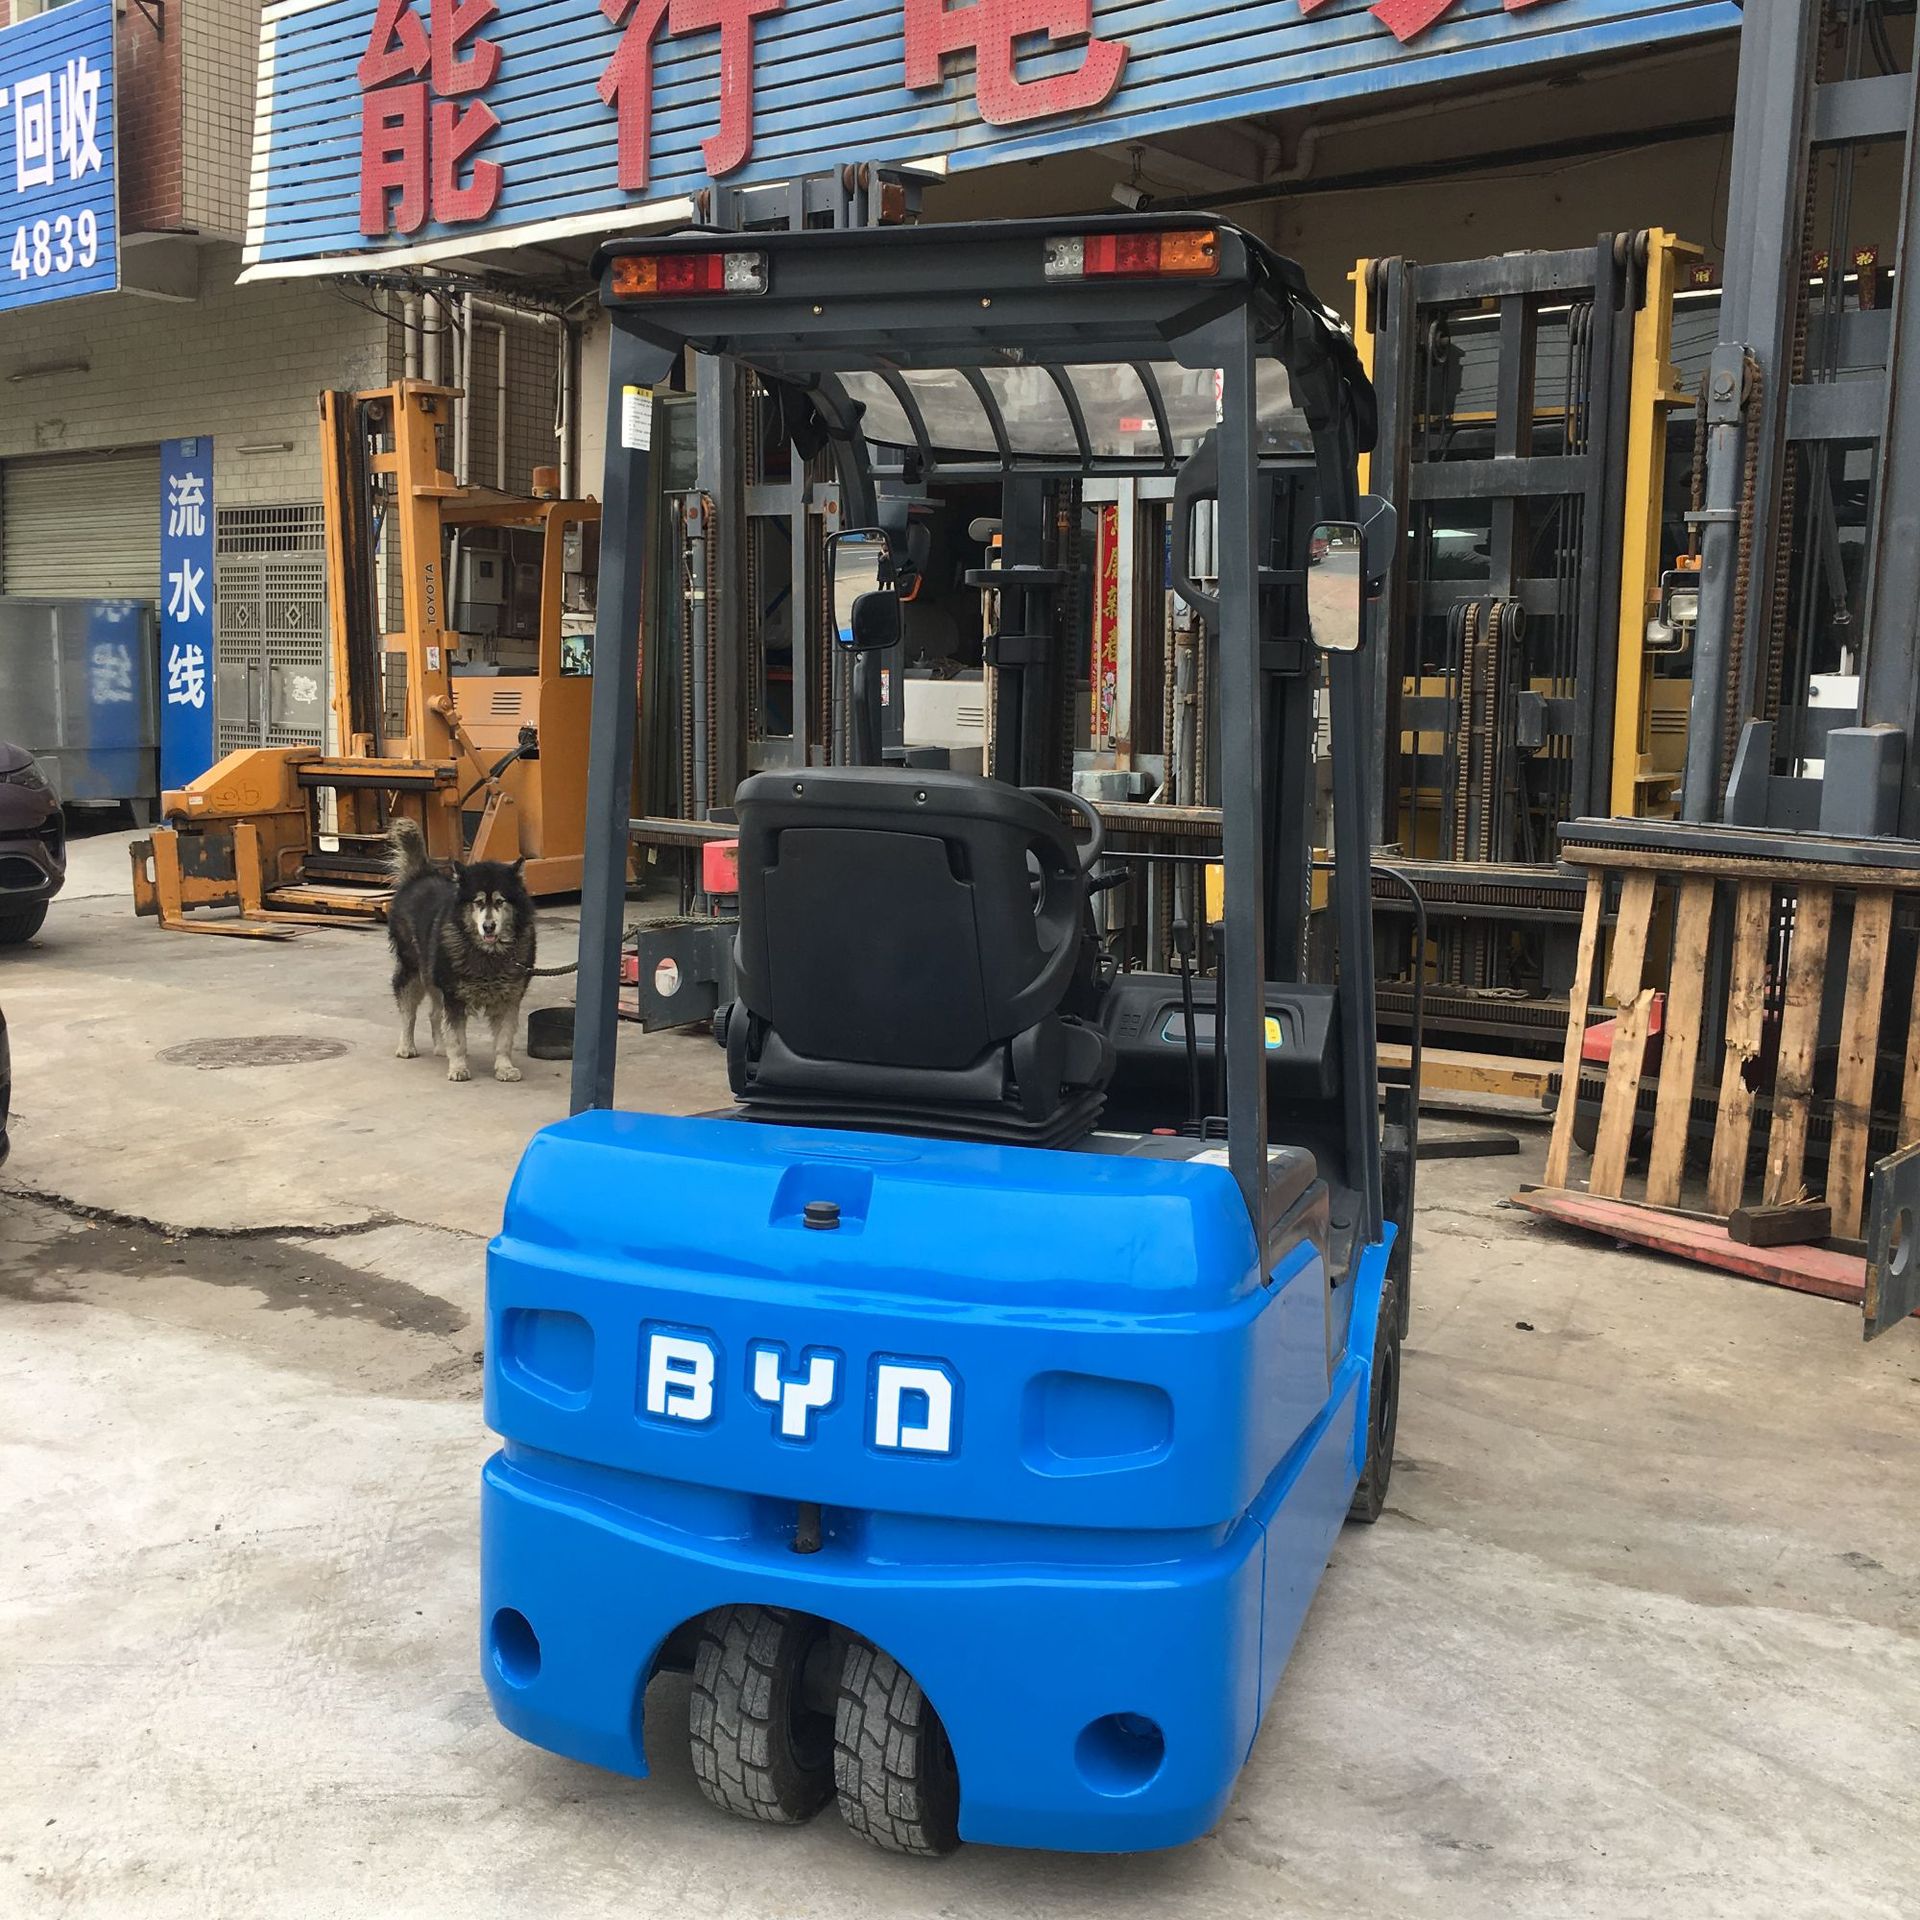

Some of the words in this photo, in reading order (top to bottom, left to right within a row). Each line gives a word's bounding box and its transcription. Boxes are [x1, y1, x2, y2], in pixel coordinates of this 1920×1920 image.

[0, 56, 103, 193] 回收
[357, 0, 1550, 235] 能行电
[11, 208, 98, 281] 4839
[167, 471, 206, 709] 流水线
[425, 563, 436, 625] TOYOTA
[646, 1333, 953, 1453] BYD
